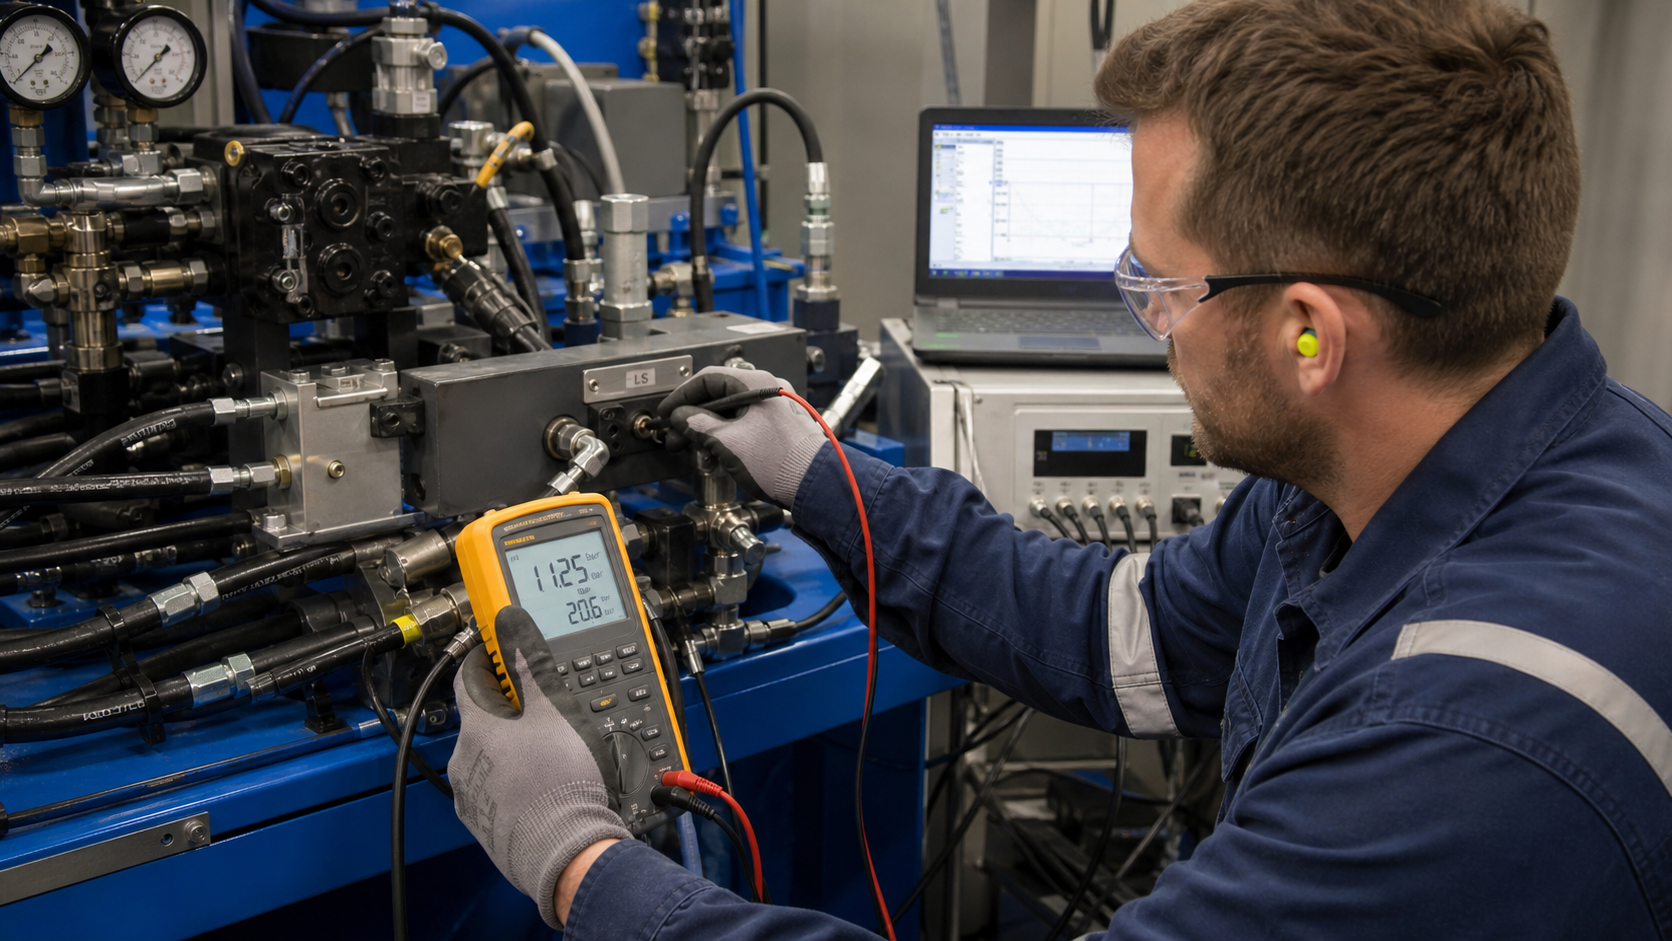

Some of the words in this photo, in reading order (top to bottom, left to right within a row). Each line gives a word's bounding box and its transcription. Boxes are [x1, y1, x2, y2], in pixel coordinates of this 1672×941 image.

[634, 372, 649, 385] LS
[533, 554, 590, 592] 11.25
[566, 595, 603, 625] 20.6
